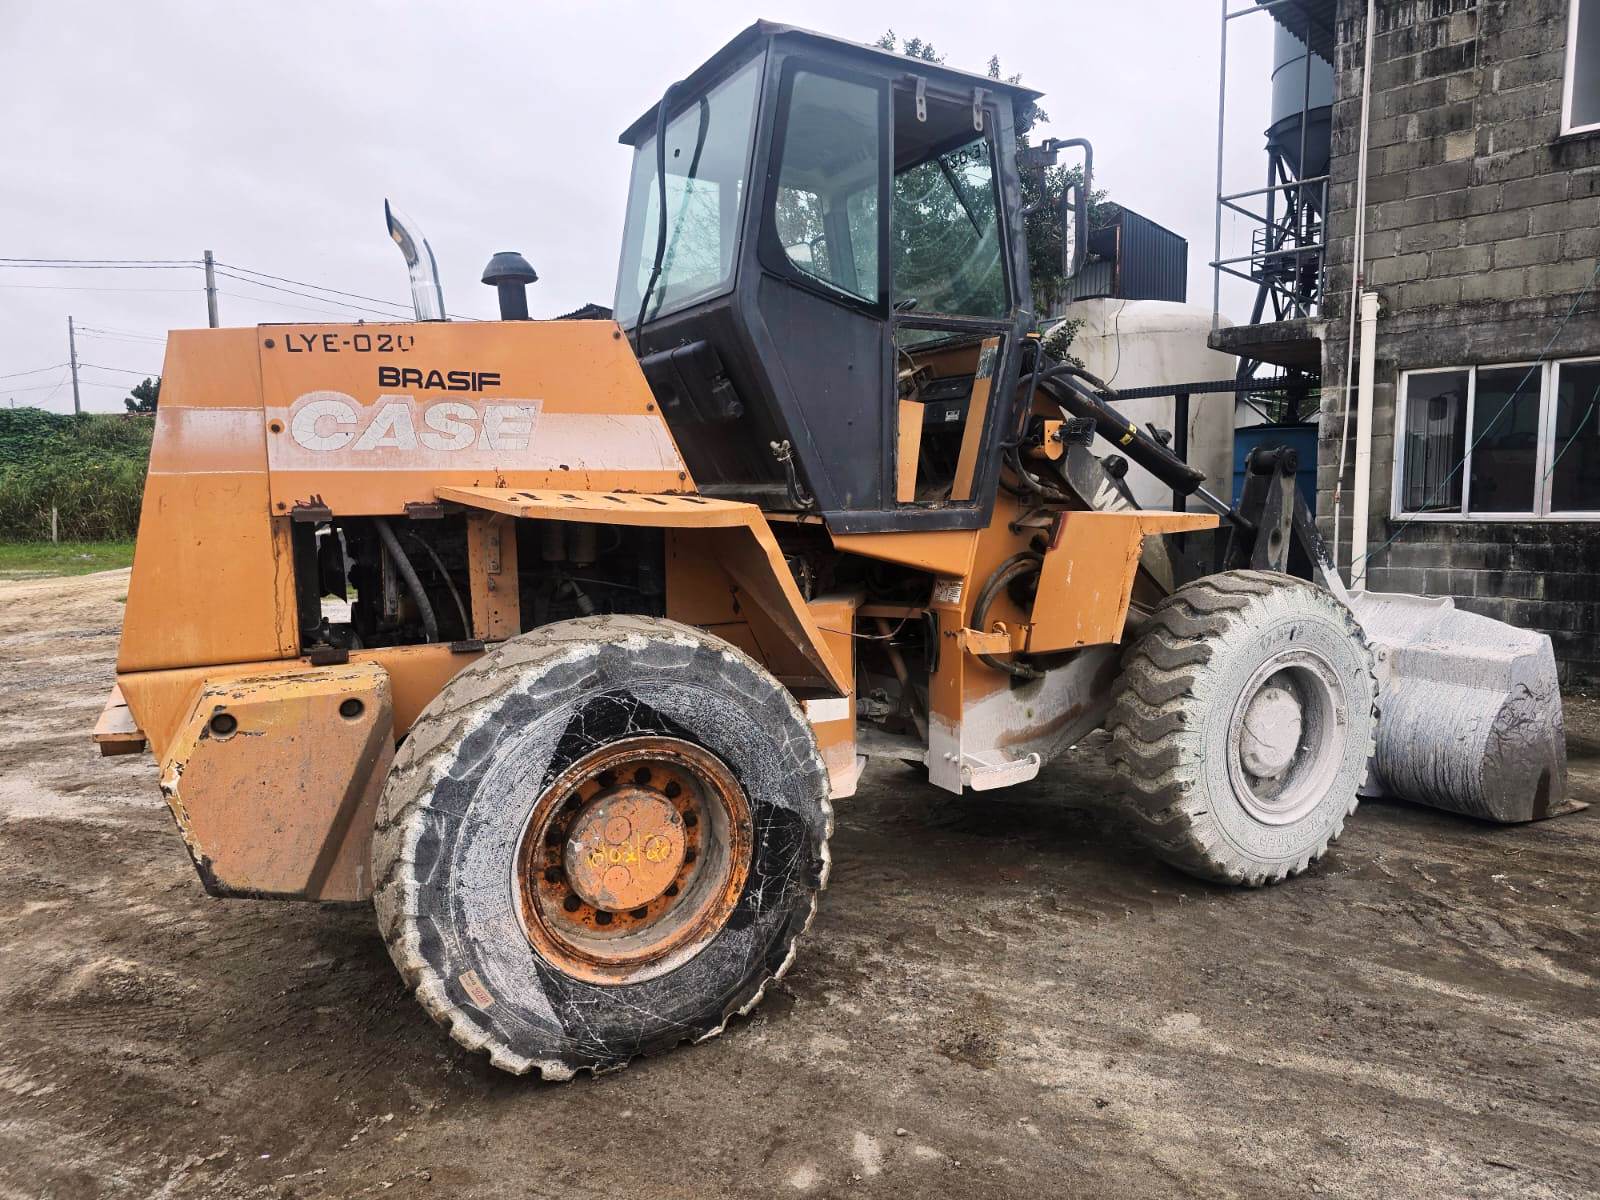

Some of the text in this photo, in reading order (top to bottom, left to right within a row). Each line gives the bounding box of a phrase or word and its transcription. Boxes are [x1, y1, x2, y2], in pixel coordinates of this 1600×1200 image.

[284, 333, 414, 353] LYE-020
[378, 366, 501, 392] BRASIF
[291, 400, 537, 451] CASE
